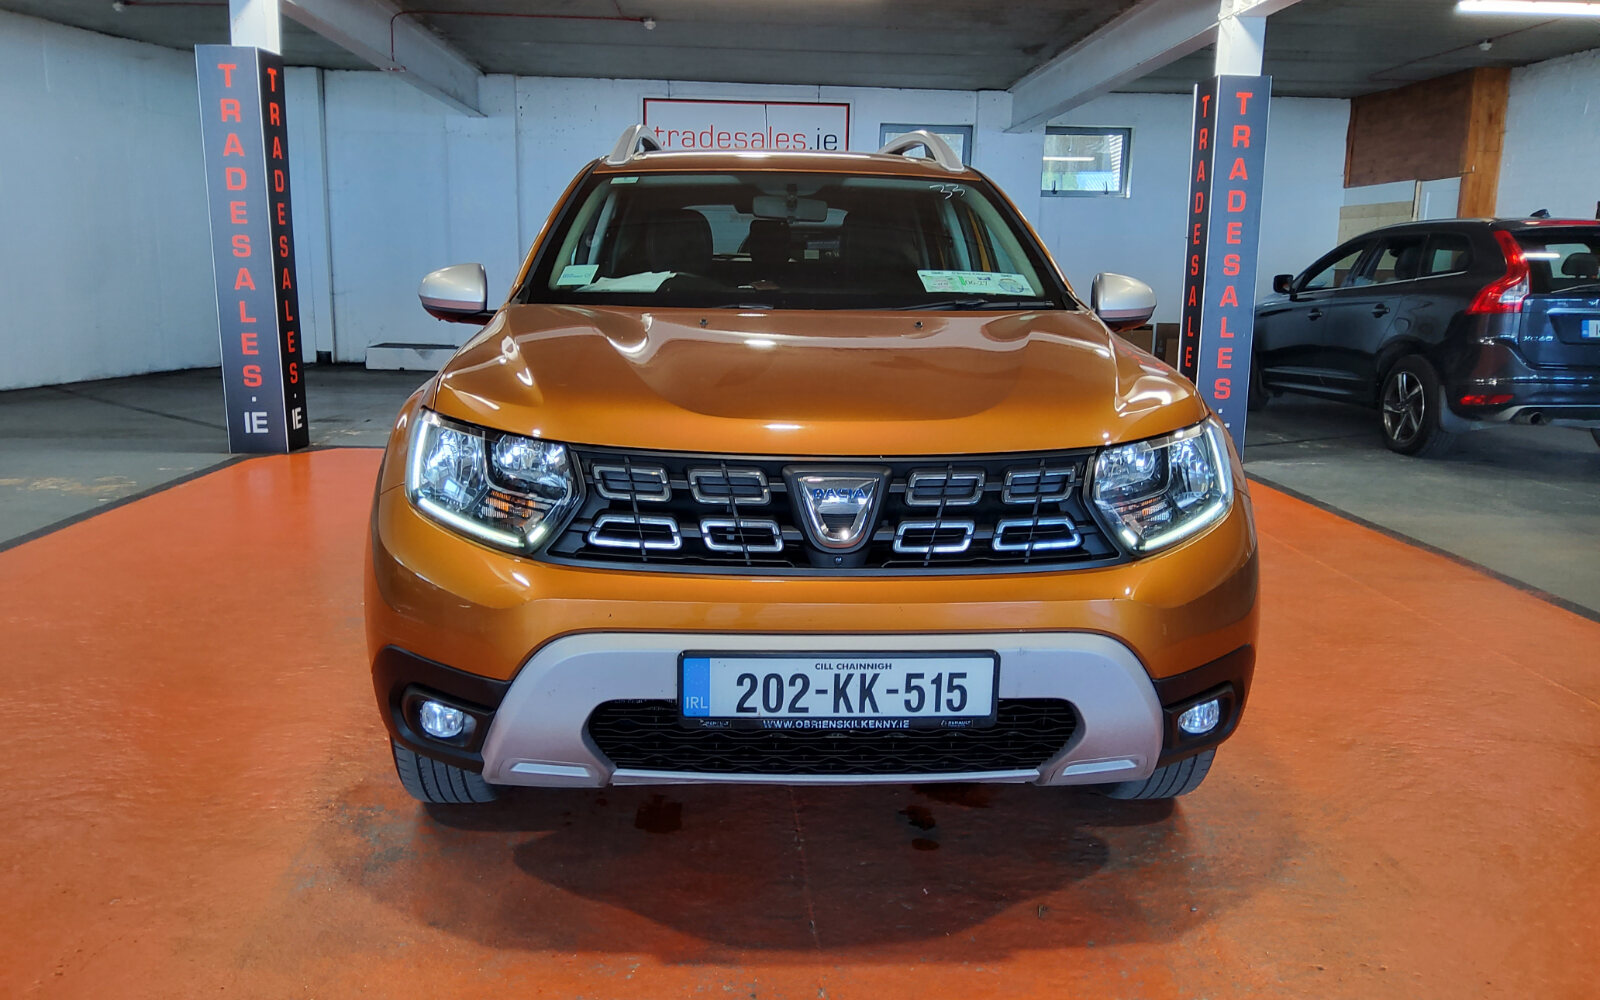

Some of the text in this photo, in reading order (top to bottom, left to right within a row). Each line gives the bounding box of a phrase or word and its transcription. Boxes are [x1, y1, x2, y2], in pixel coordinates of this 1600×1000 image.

[654, 124, 838, 150] tradesales.ie
[812, 488, 866, 500] DACIA
[735, 672, 968, 714] 202-KK-515
[685, 696, 708, 709] IRL
[763, 720, 910, 729] WWW.OBRIENSKILKENNY.IE
